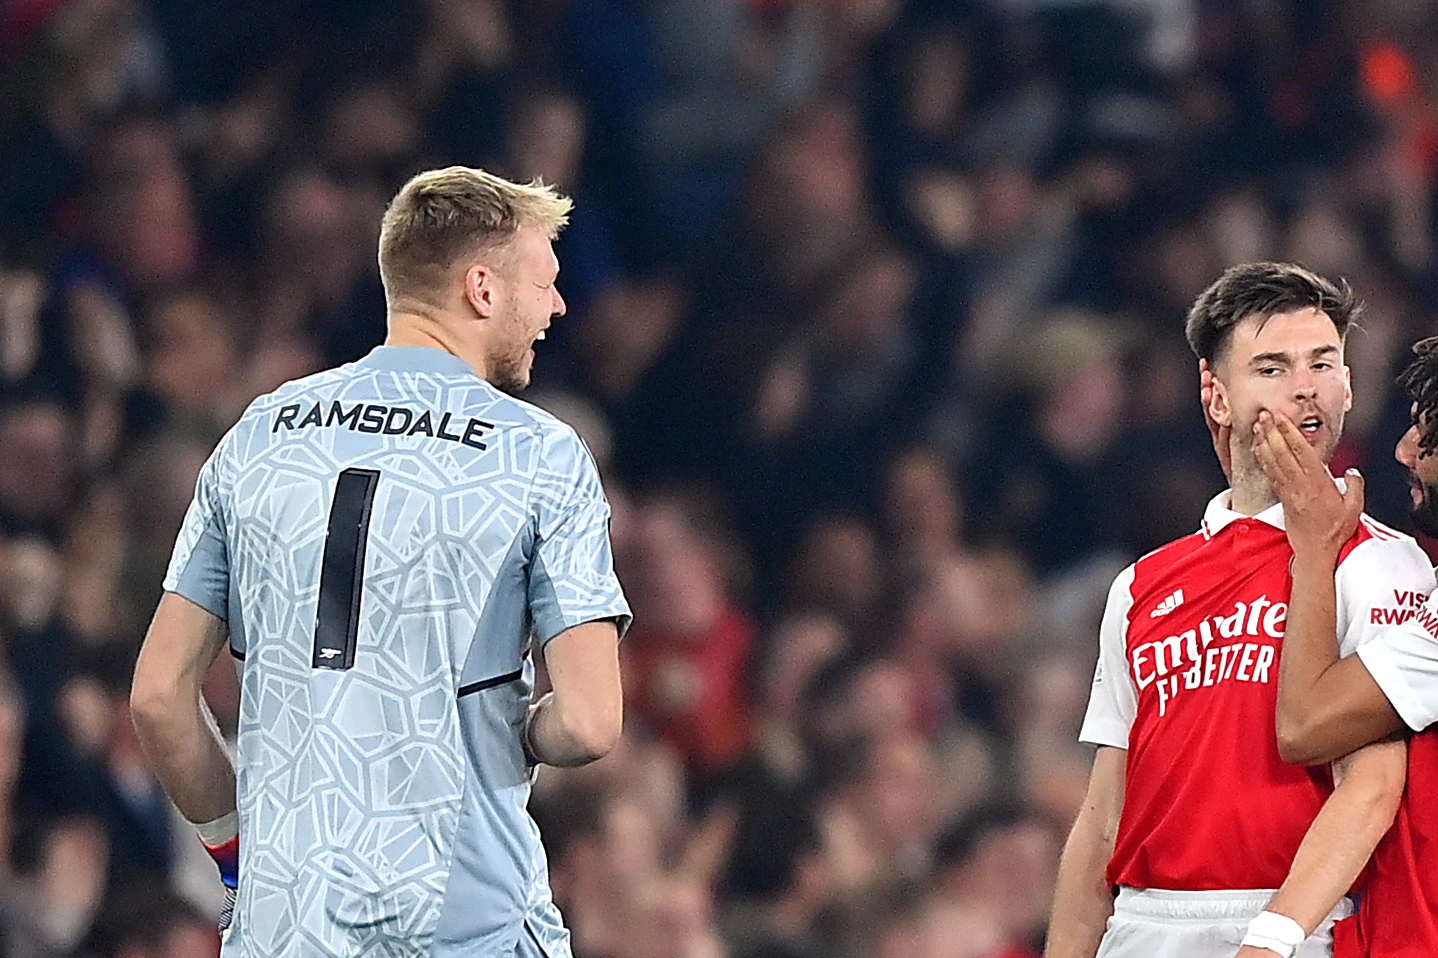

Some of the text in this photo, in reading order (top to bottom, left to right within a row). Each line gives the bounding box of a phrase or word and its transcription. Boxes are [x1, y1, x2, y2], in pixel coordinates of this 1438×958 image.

[272, 400, 495, 451] RAMSDALE
[312, 467, 381, 672] 1
[1370, 607, 1415, 625] RWA
[1393, 589, 1430, 609] VIS
